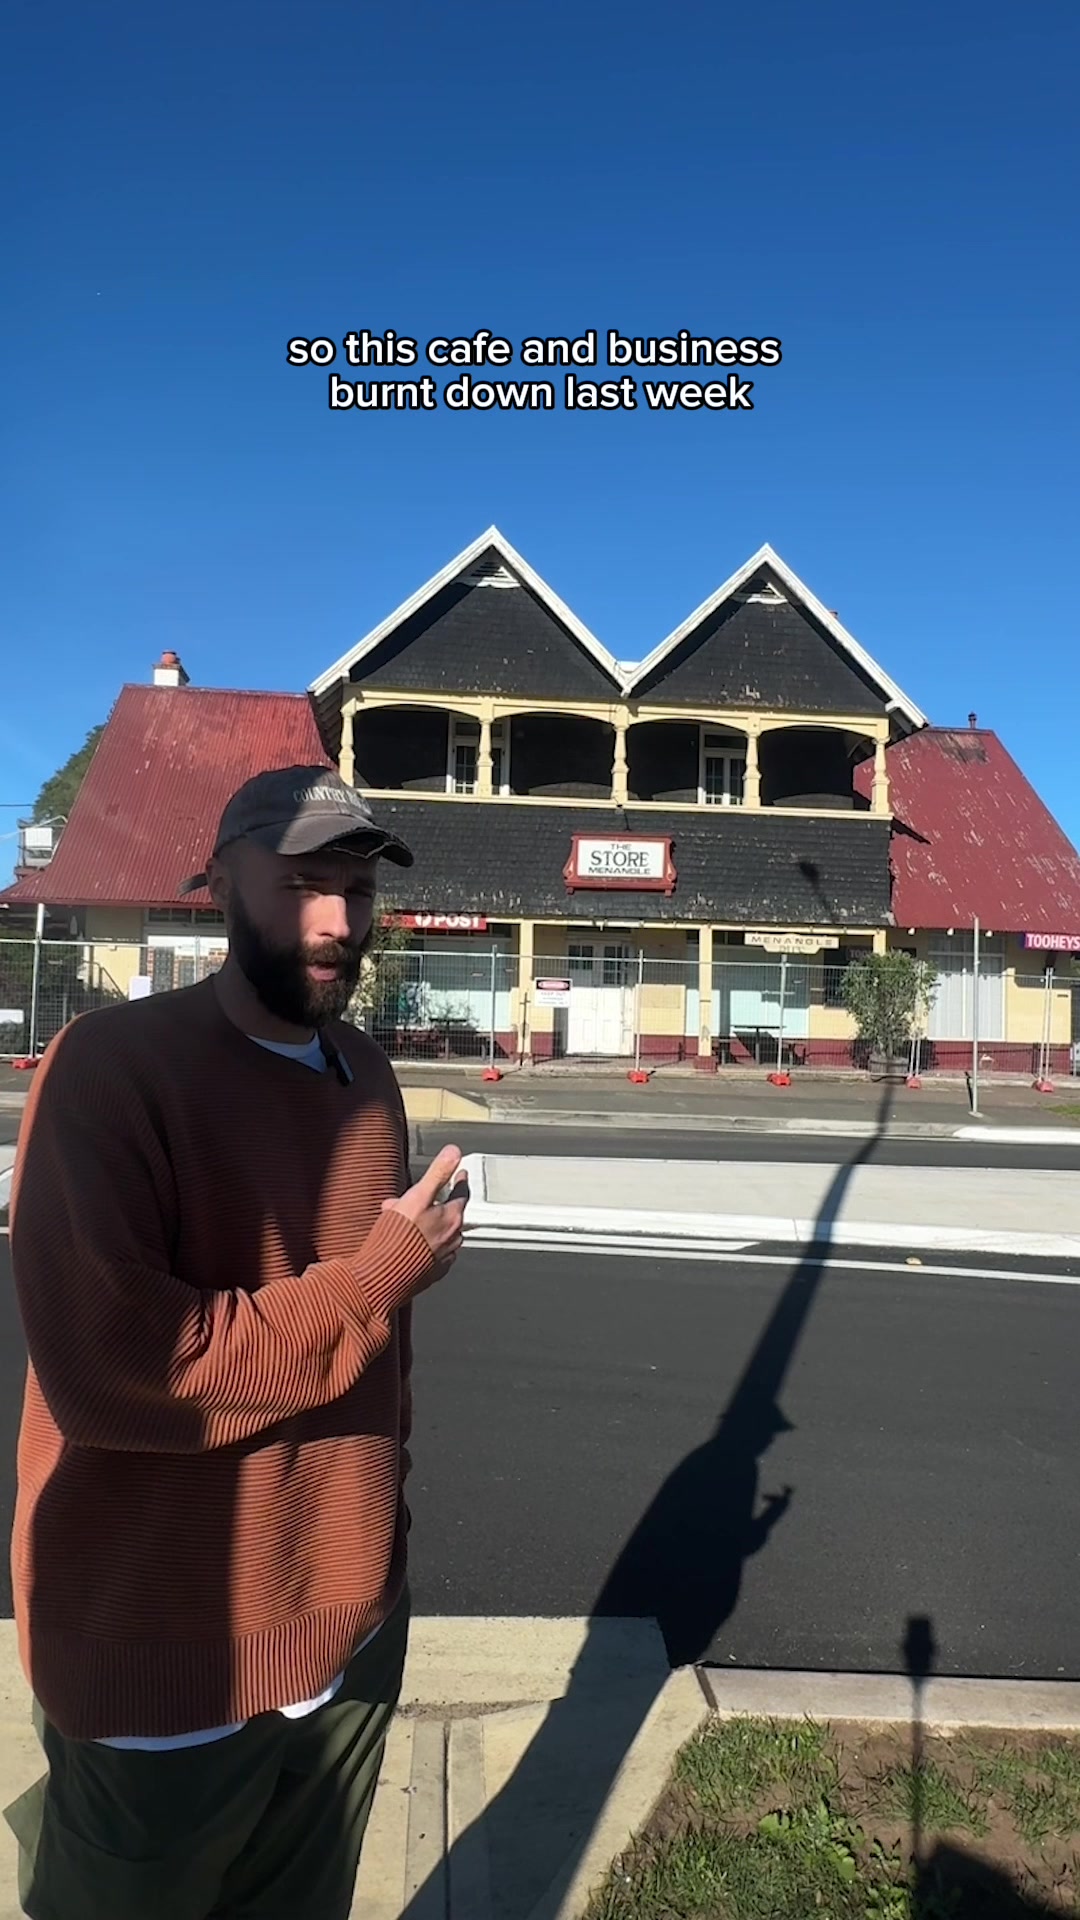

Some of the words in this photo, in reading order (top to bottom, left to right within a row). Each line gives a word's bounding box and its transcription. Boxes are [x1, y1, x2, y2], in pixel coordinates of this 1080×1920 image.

[293, 786, 347, 803] COUNTRY
[590, 850, 650, 867] STORE
[588, 867, 651, 875] MENANGLE
[434, 912, 482, 928] POST
[751, 936, 833, 946] MENANGLE
[1027, 933, 1080, 949] TOOHEYS
